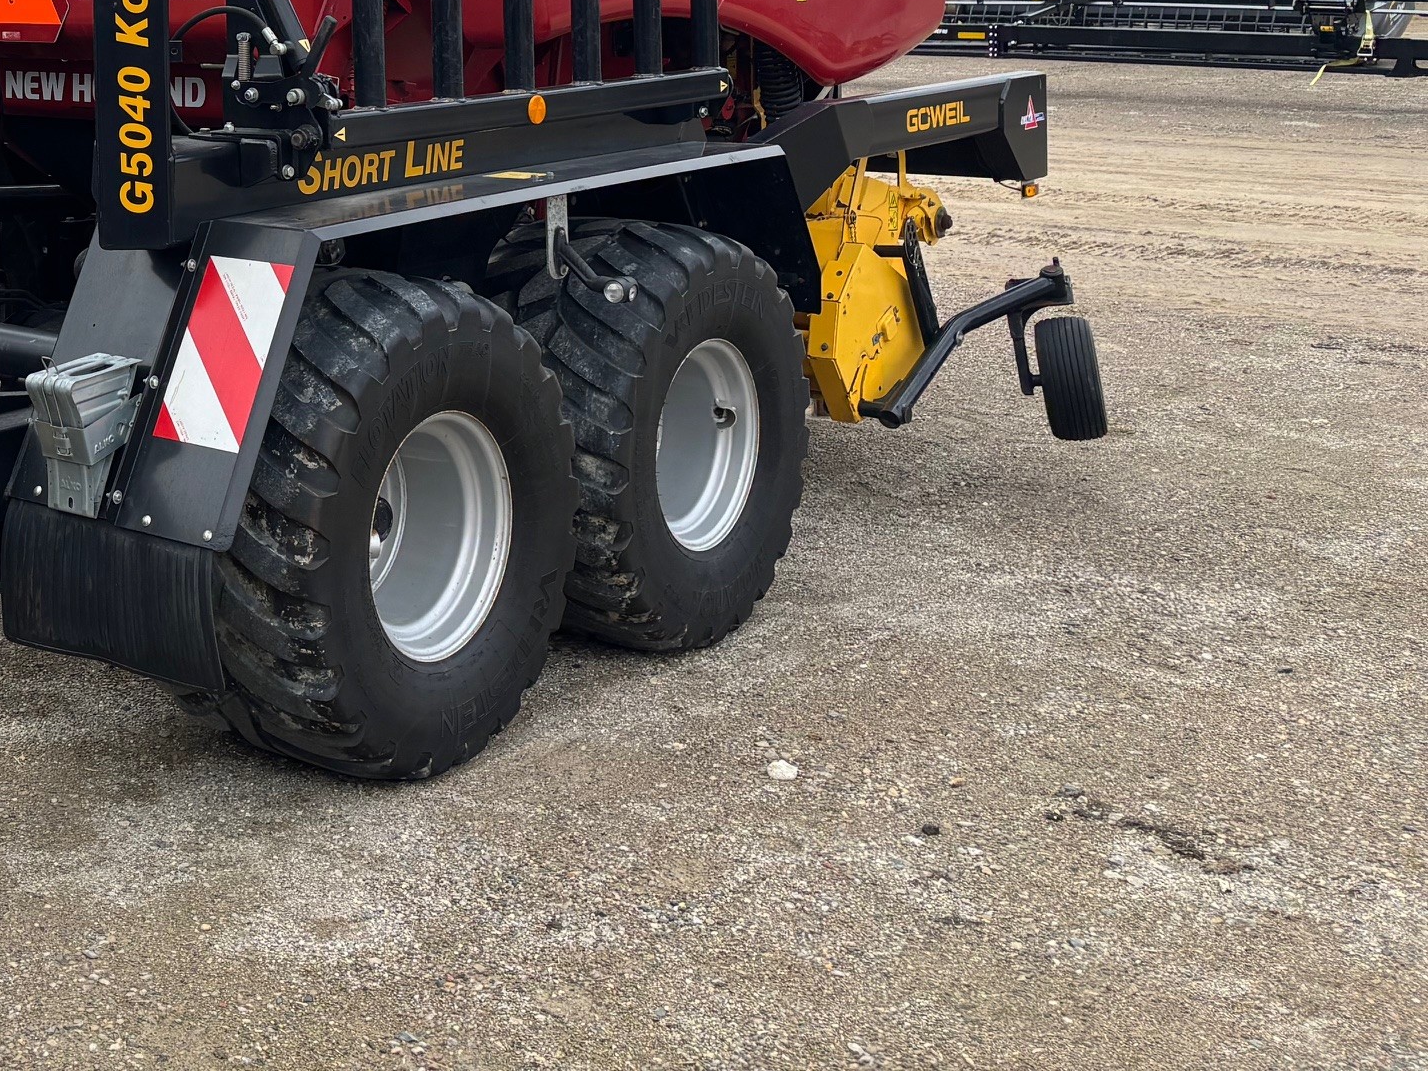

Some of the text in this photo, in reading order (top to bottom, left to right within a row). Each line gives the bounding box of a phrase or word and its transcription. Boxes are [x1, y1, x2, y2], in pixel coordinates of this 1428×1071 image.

[5, 70, 66, 101] NEW
[118, 66, 155, 214] G5040
[405, 139, 465, 178] LINE
